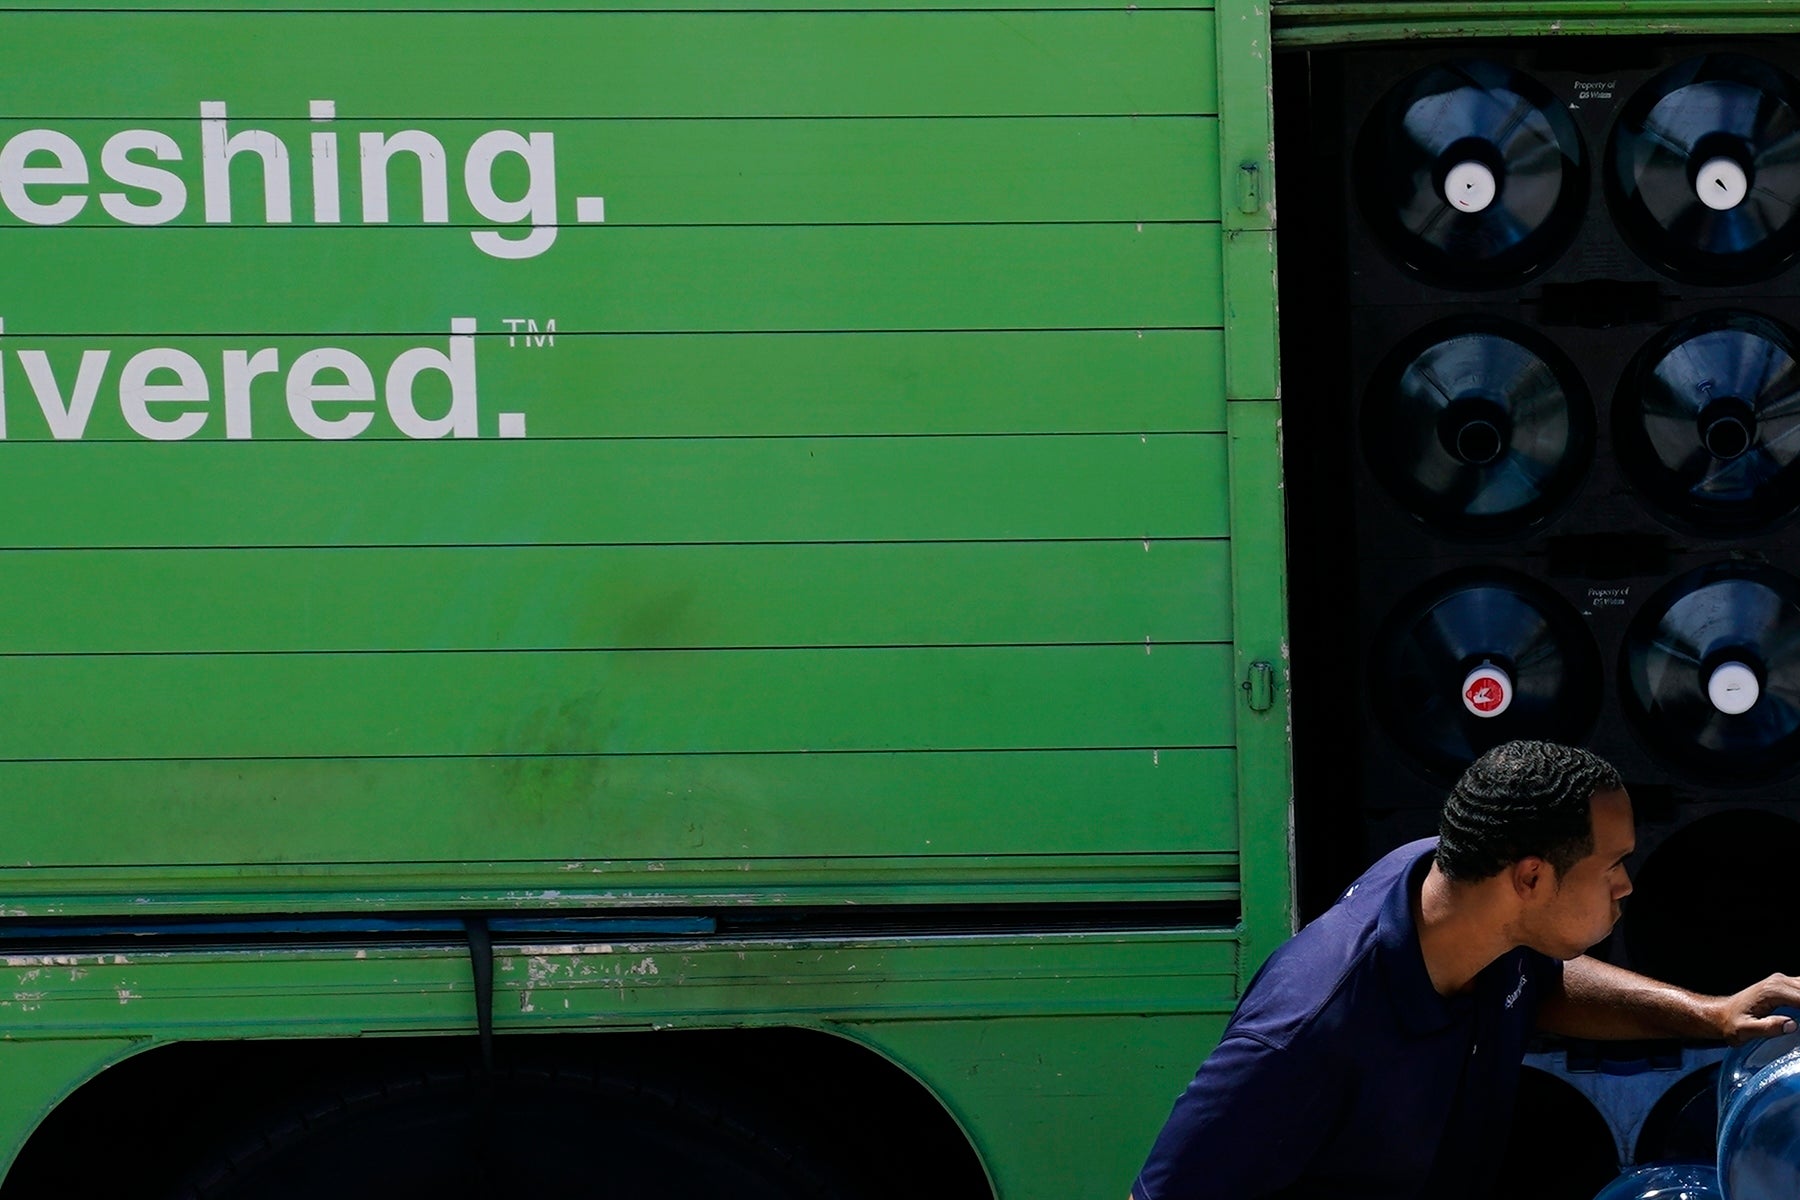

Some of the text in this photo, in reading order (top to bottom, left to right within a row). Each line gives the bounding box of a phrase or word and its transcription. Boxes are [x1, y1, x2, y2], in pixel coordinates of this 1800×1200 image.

[1574, 81, 1606, 91] Property
[0, 100, 604, 259] eshing.
[0, 317, 526, 440] vered.
